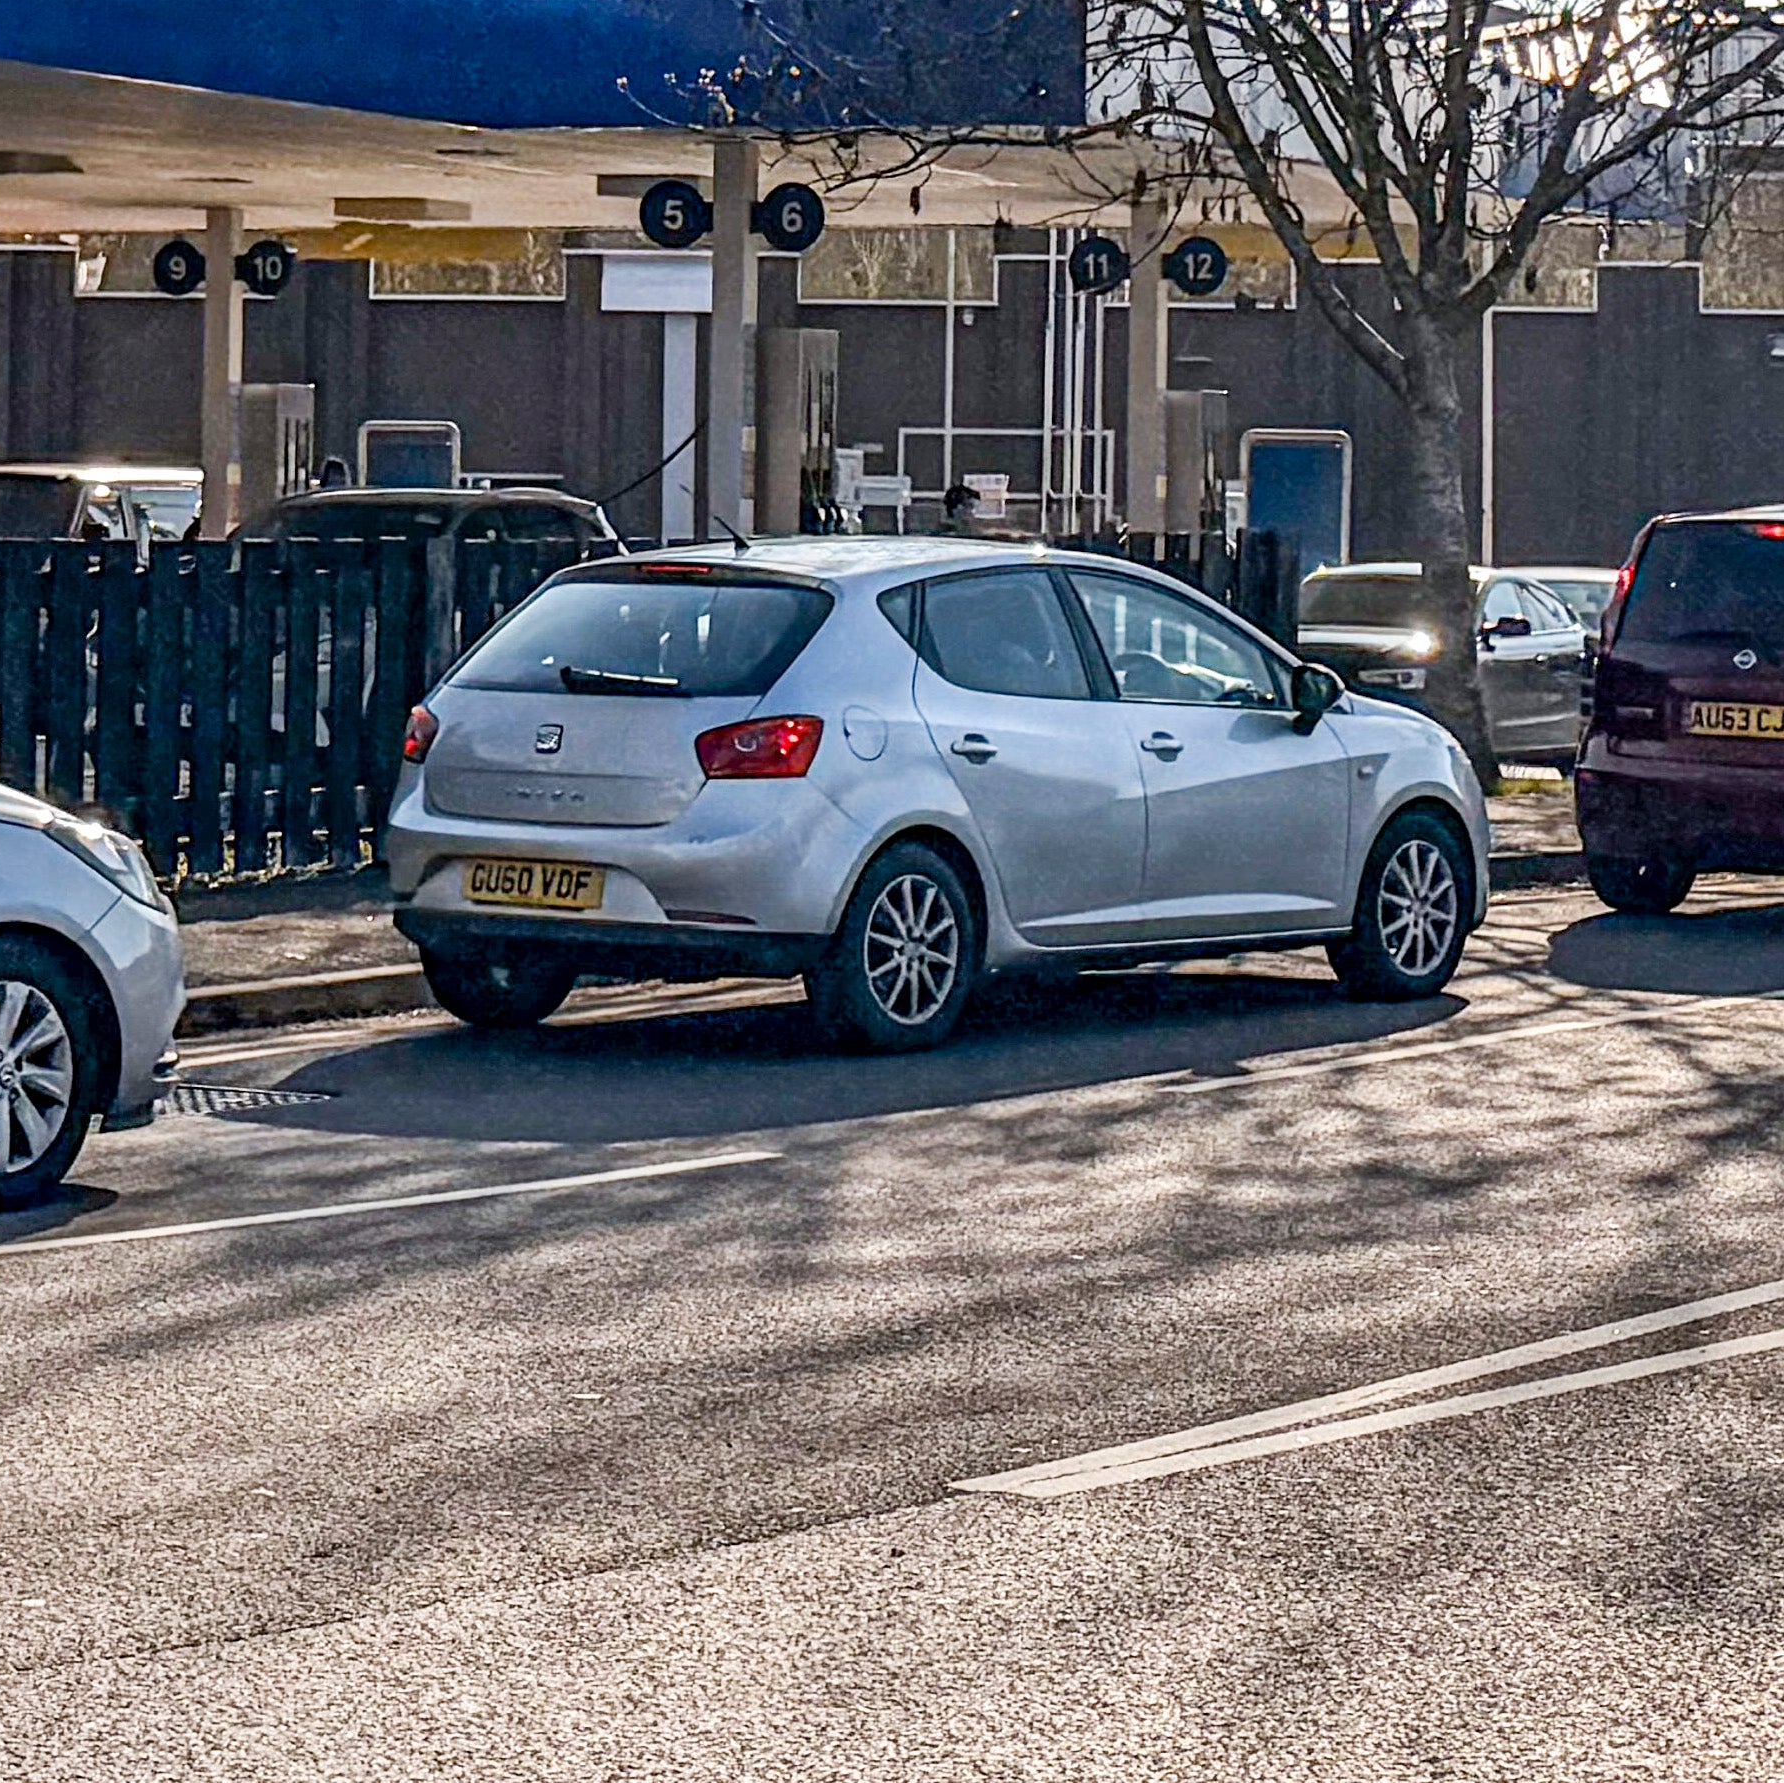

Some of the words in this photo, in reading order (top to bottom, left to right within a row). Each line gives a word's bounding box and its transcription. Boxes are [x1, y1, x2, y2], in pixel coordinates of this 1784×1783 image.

[662, 199, 684, 230] 5
[781, 201, 804, 233] 6
[168, 255, 187, 281] 9
[254, 255, 283, 282] 10
[1083, 253, 1109, 281] 11
[1183, 253, 1214, 281] 12
[1690, 706, 1750, 730] AU63
[471, 863, 533, 895] GU60
[541, 865, 592, 900] VDF
